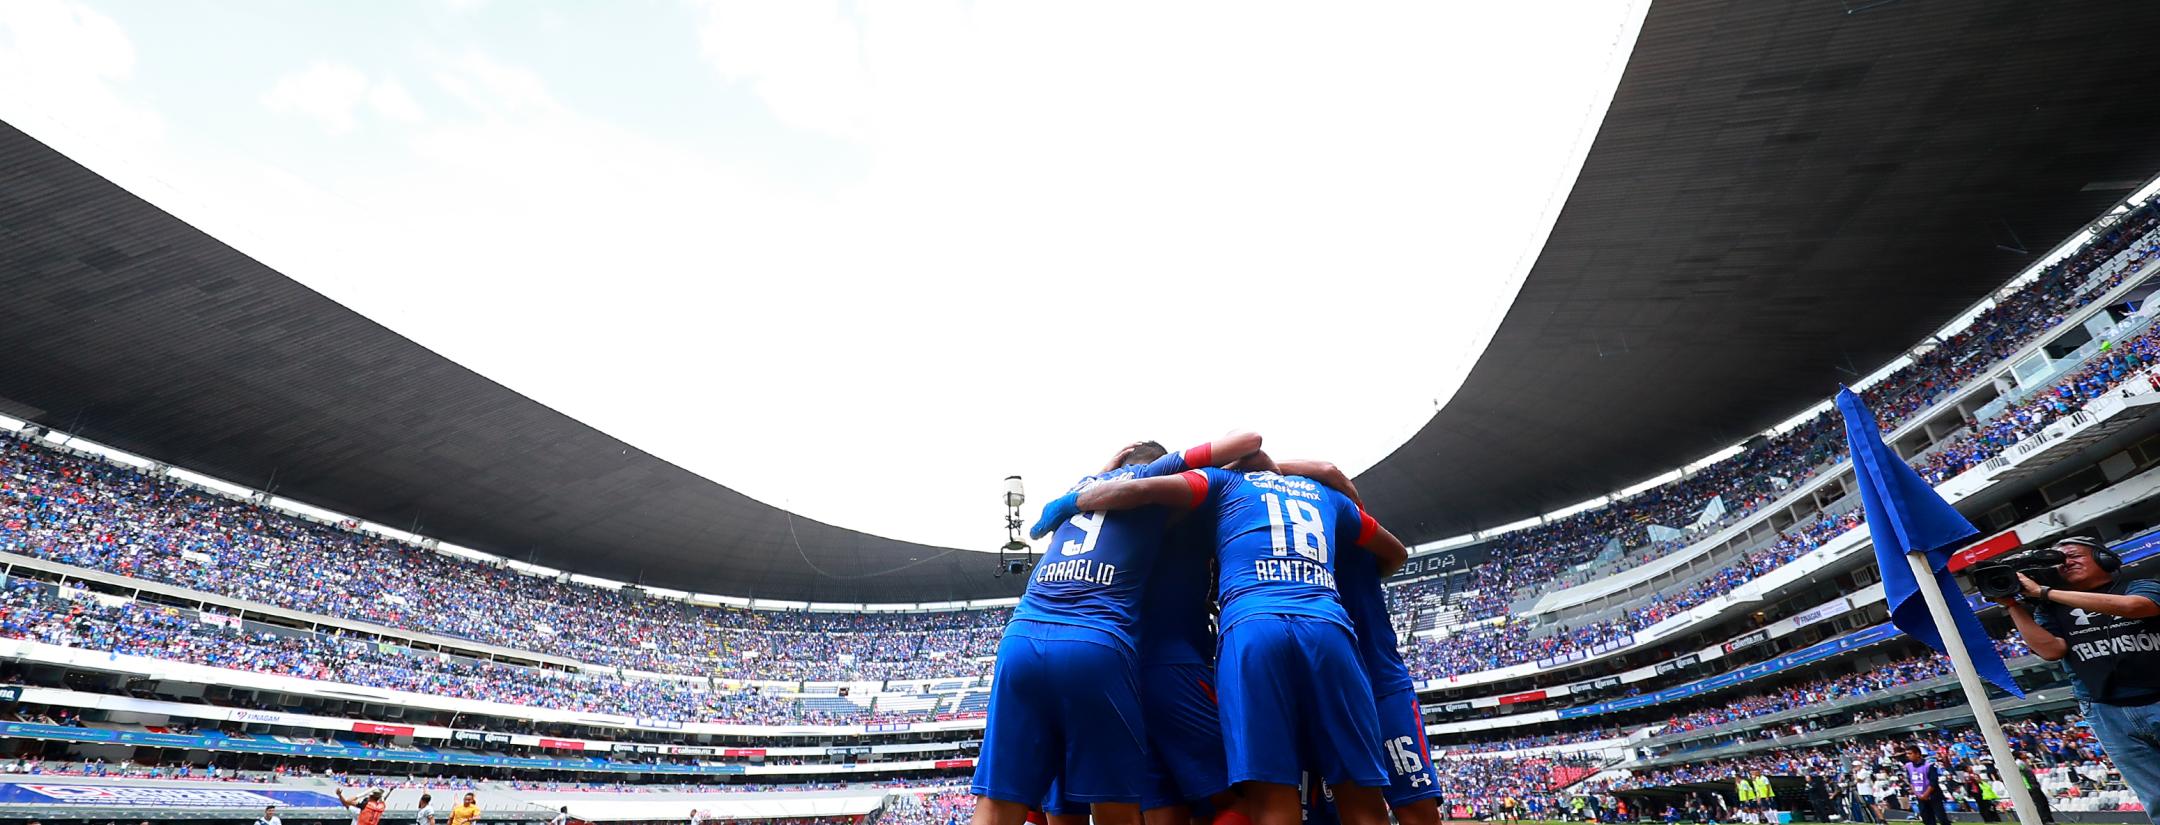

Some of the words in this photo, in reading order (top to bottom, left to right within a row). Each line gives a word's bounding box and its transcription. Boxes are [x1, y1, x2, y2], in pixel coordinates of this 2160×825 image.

[1261, 492, 1328, 564] 18
[1036, 559, 1116, 586] CARAGLIO
[1255, 559, 1336, 590] RENTERIA
[2068, 626, 2101, 636] UNDER
[2071, 629, 2160, 662] TELEVISIÓN
[1570, 683, 1592, 694] Corona
[1594, 677, 1617, 689] Corona
[1445, 703, 1469, 712] Corona
[455, 731, 481, 742] Corona
[484, 733, 510, 744] Corona
[1384, 735, 1423, 776] 16
